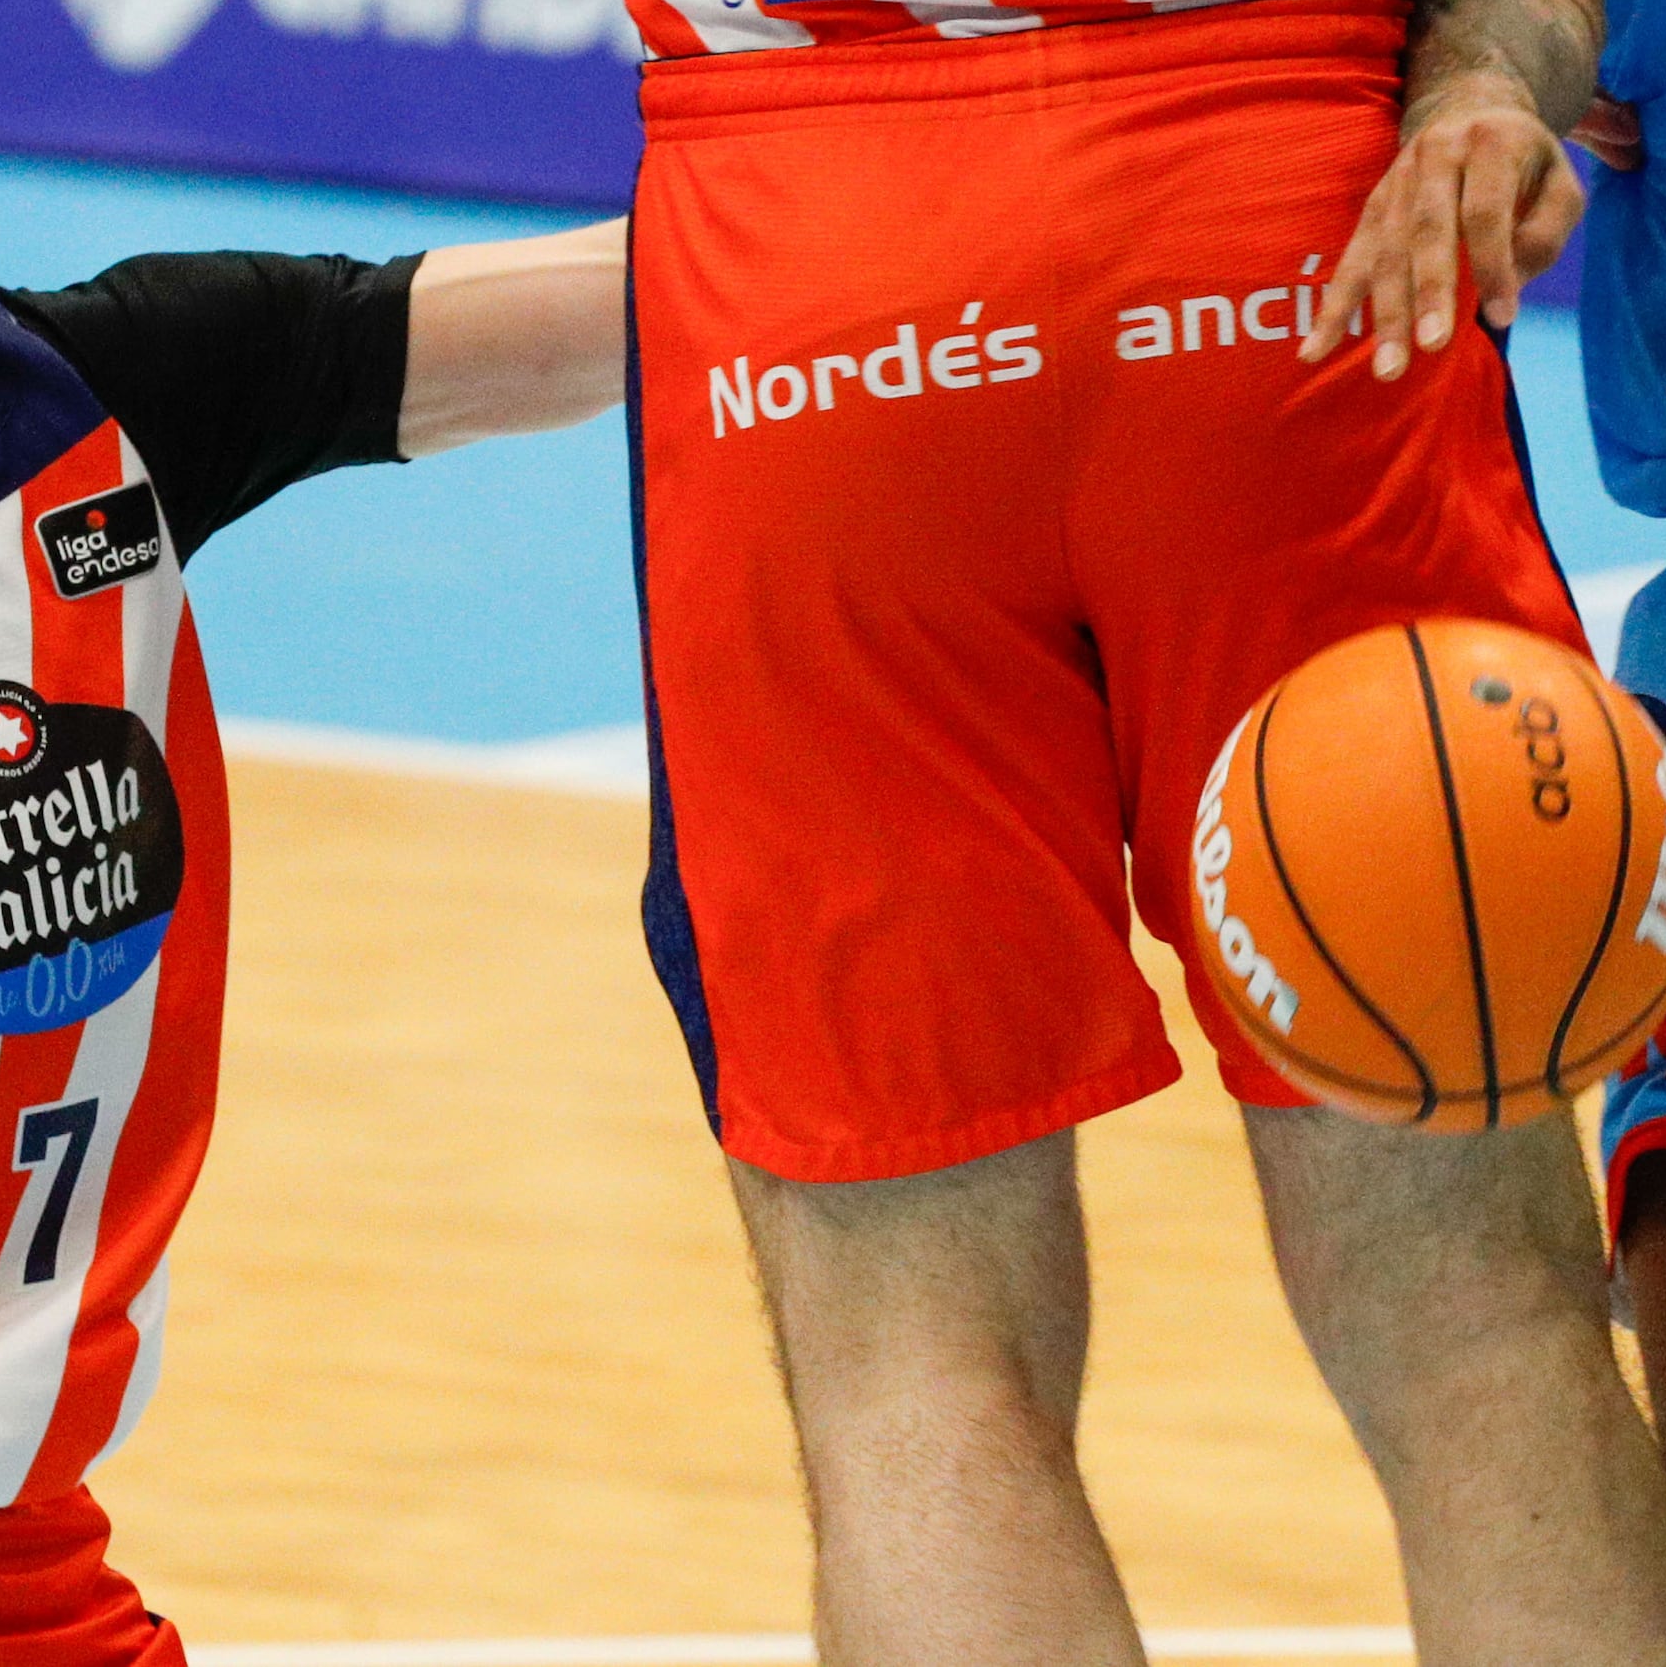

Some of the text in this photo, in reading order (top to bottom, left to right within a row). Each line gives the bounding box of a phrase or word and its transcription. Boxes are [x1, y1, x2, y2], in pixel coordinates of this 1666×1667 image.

[709, 300, 1043, 439] Nordés
[56, 531, 108, 561] liga
[67, 537, 159, 584] endesa
[26, 936, 93, 1018] 0,0
[18, 1097, 99, 1286] 7
